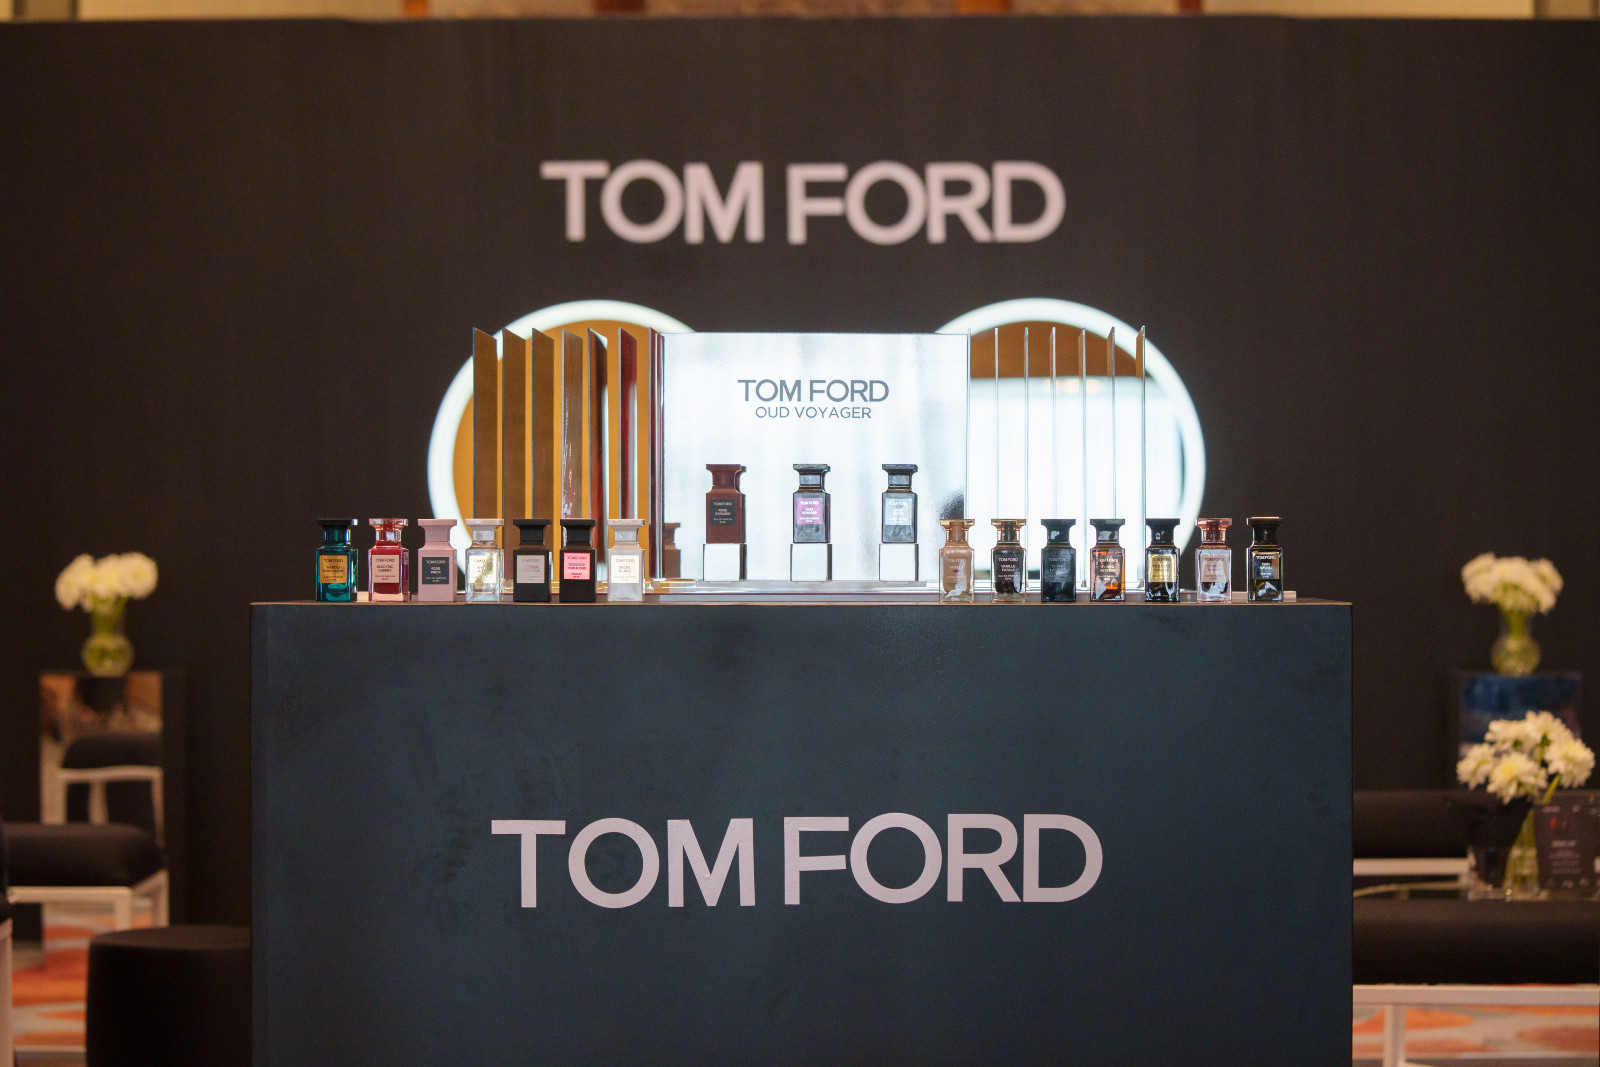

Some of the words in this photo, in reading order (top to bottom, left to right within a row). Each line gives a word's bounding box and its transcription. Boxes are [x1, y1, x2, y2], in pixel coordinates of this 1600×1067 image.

[541, 160, 764, 244] TOM
[786, 161, 1066, 245] FORD
[737, 379, 802, 402] TOM
[809, 379, 889, 402] FORD
[755, 406, 790, 419] OUD
[795, 406, 872, 419] VOYAGER
[491, 817, 756, 909] TOM
[783, 812, 1103, 906] FORD
